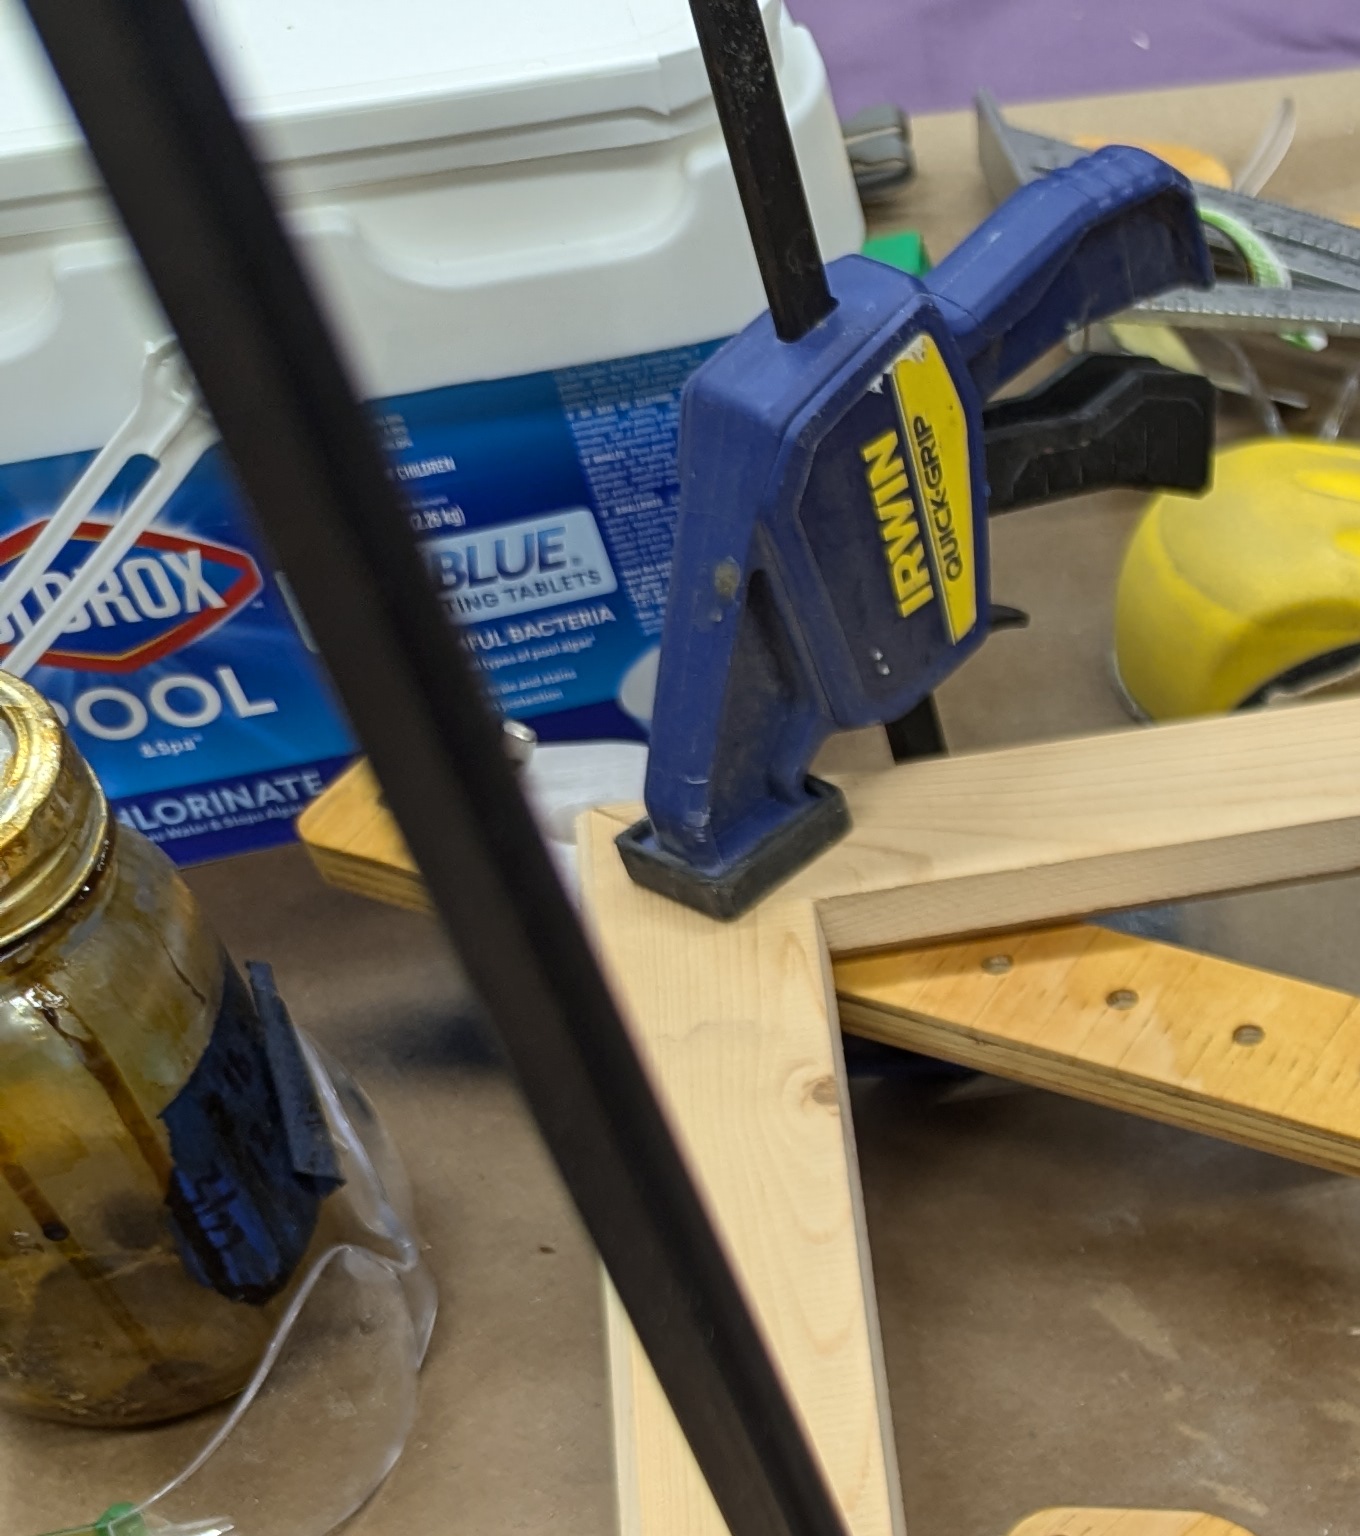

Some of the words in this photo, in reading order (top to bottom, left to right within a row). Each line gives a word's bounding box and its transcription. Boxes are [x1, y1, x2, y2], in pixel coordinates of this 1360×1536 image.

[861, 430, 934, 618] IRWIN
[913, 414, 963, 582] QUICK-GRIP
[0, 550, 227, 643] OROX
[503, 569, 601, 602] TABLETS
[509, 604, 616, 643] BACTERIA
[50, 665, 278, 741] OOL
